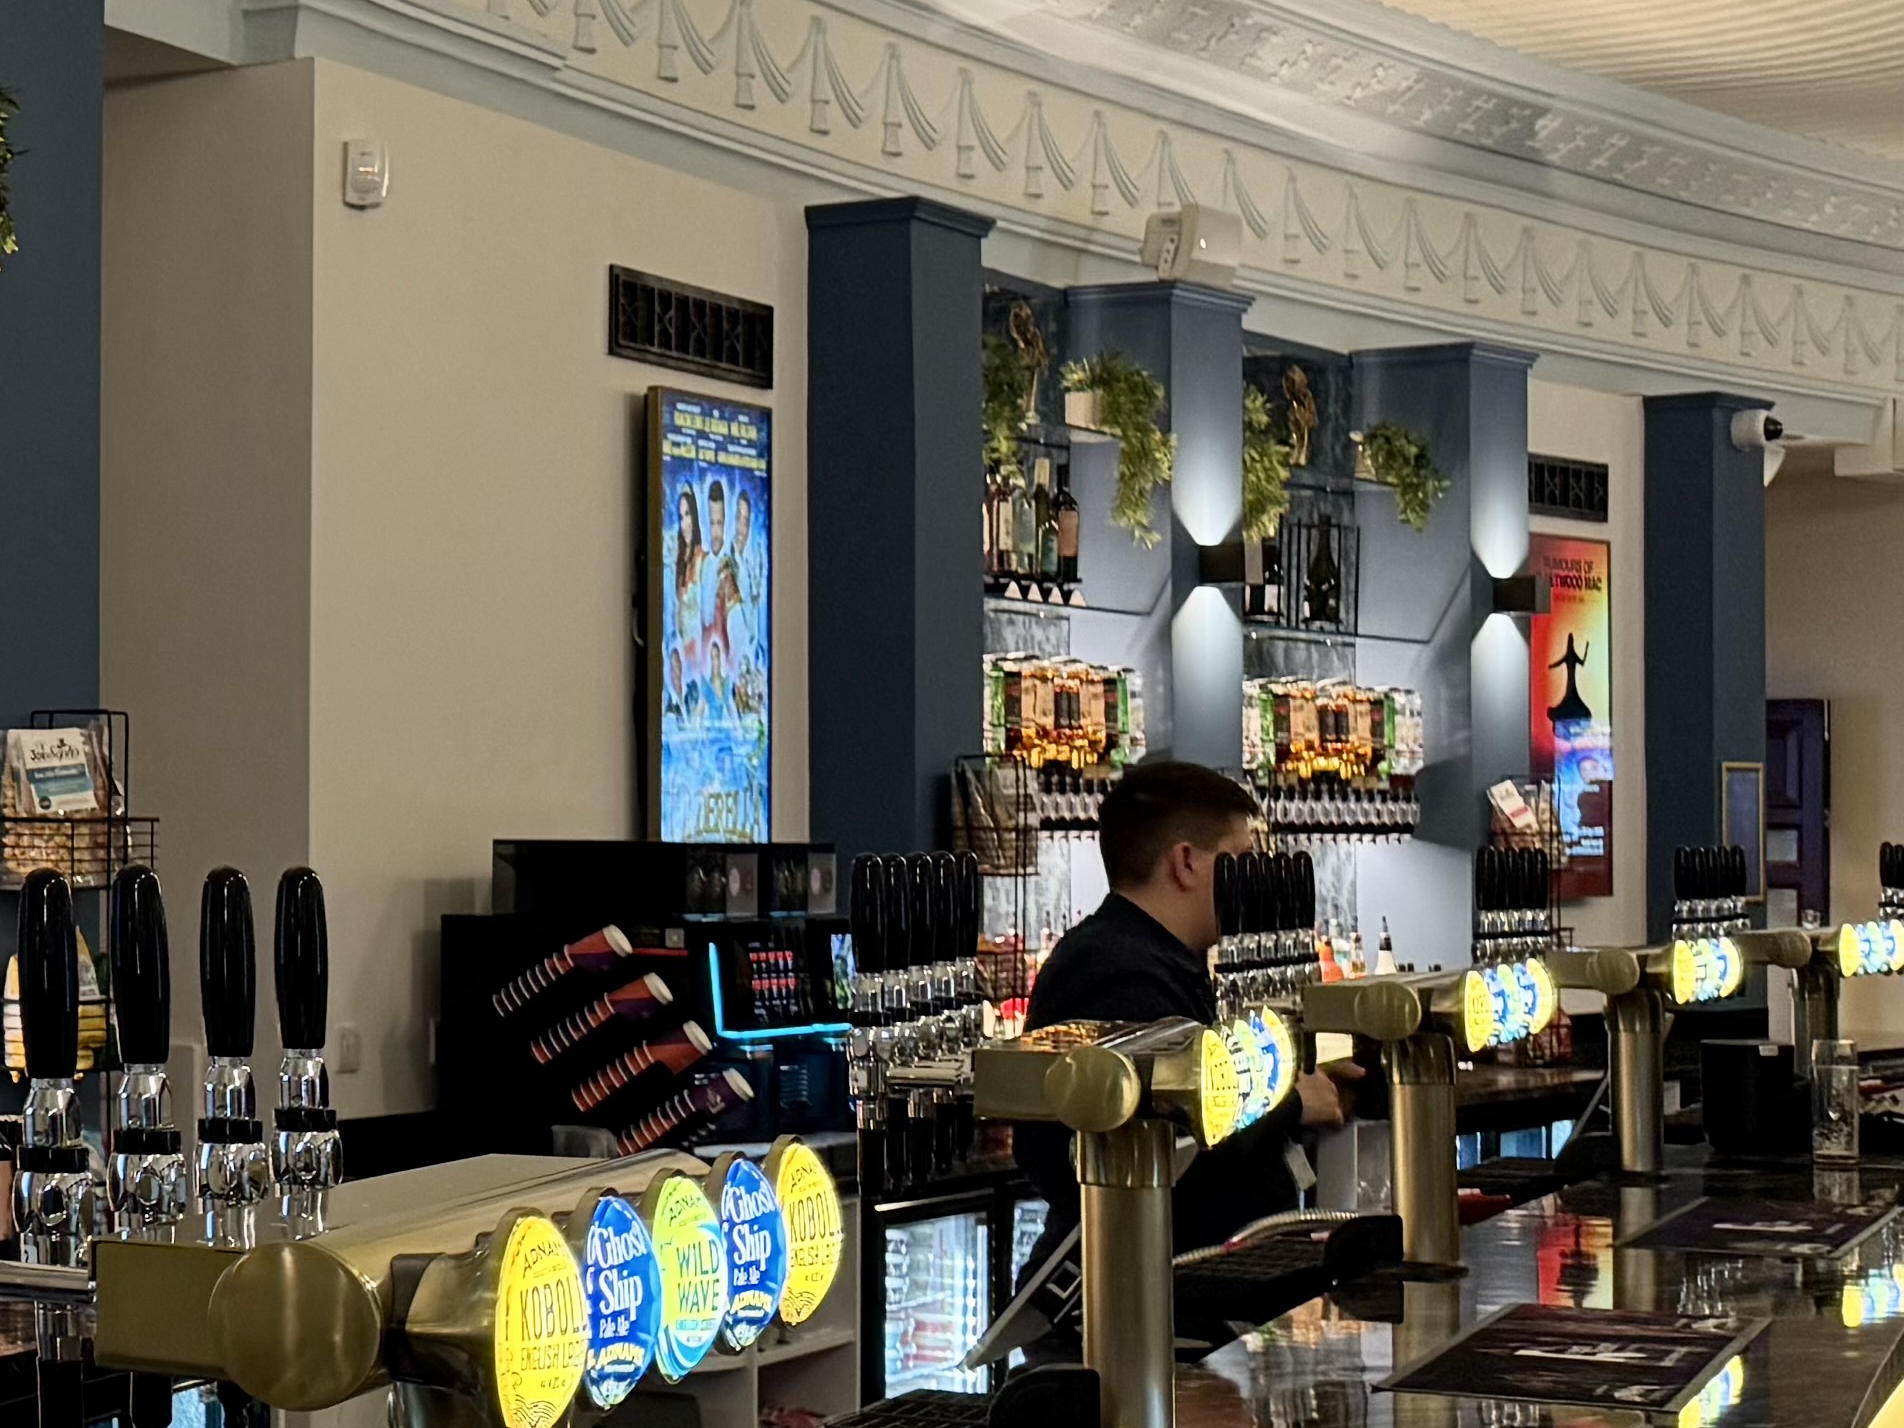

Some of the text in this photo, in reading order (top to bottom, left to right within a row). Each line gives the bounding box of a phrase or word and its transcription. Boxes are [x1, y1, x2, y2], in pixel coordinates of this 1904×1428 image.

[676, 1236, 720, 1278] WILD
[733, 1223, 771, 1271] Ship
[520, 1273, 586, 1342] KOBOL
[599, 1268, 642, 1322] Ship
[678, 1278, 720, 1314] WAVE
